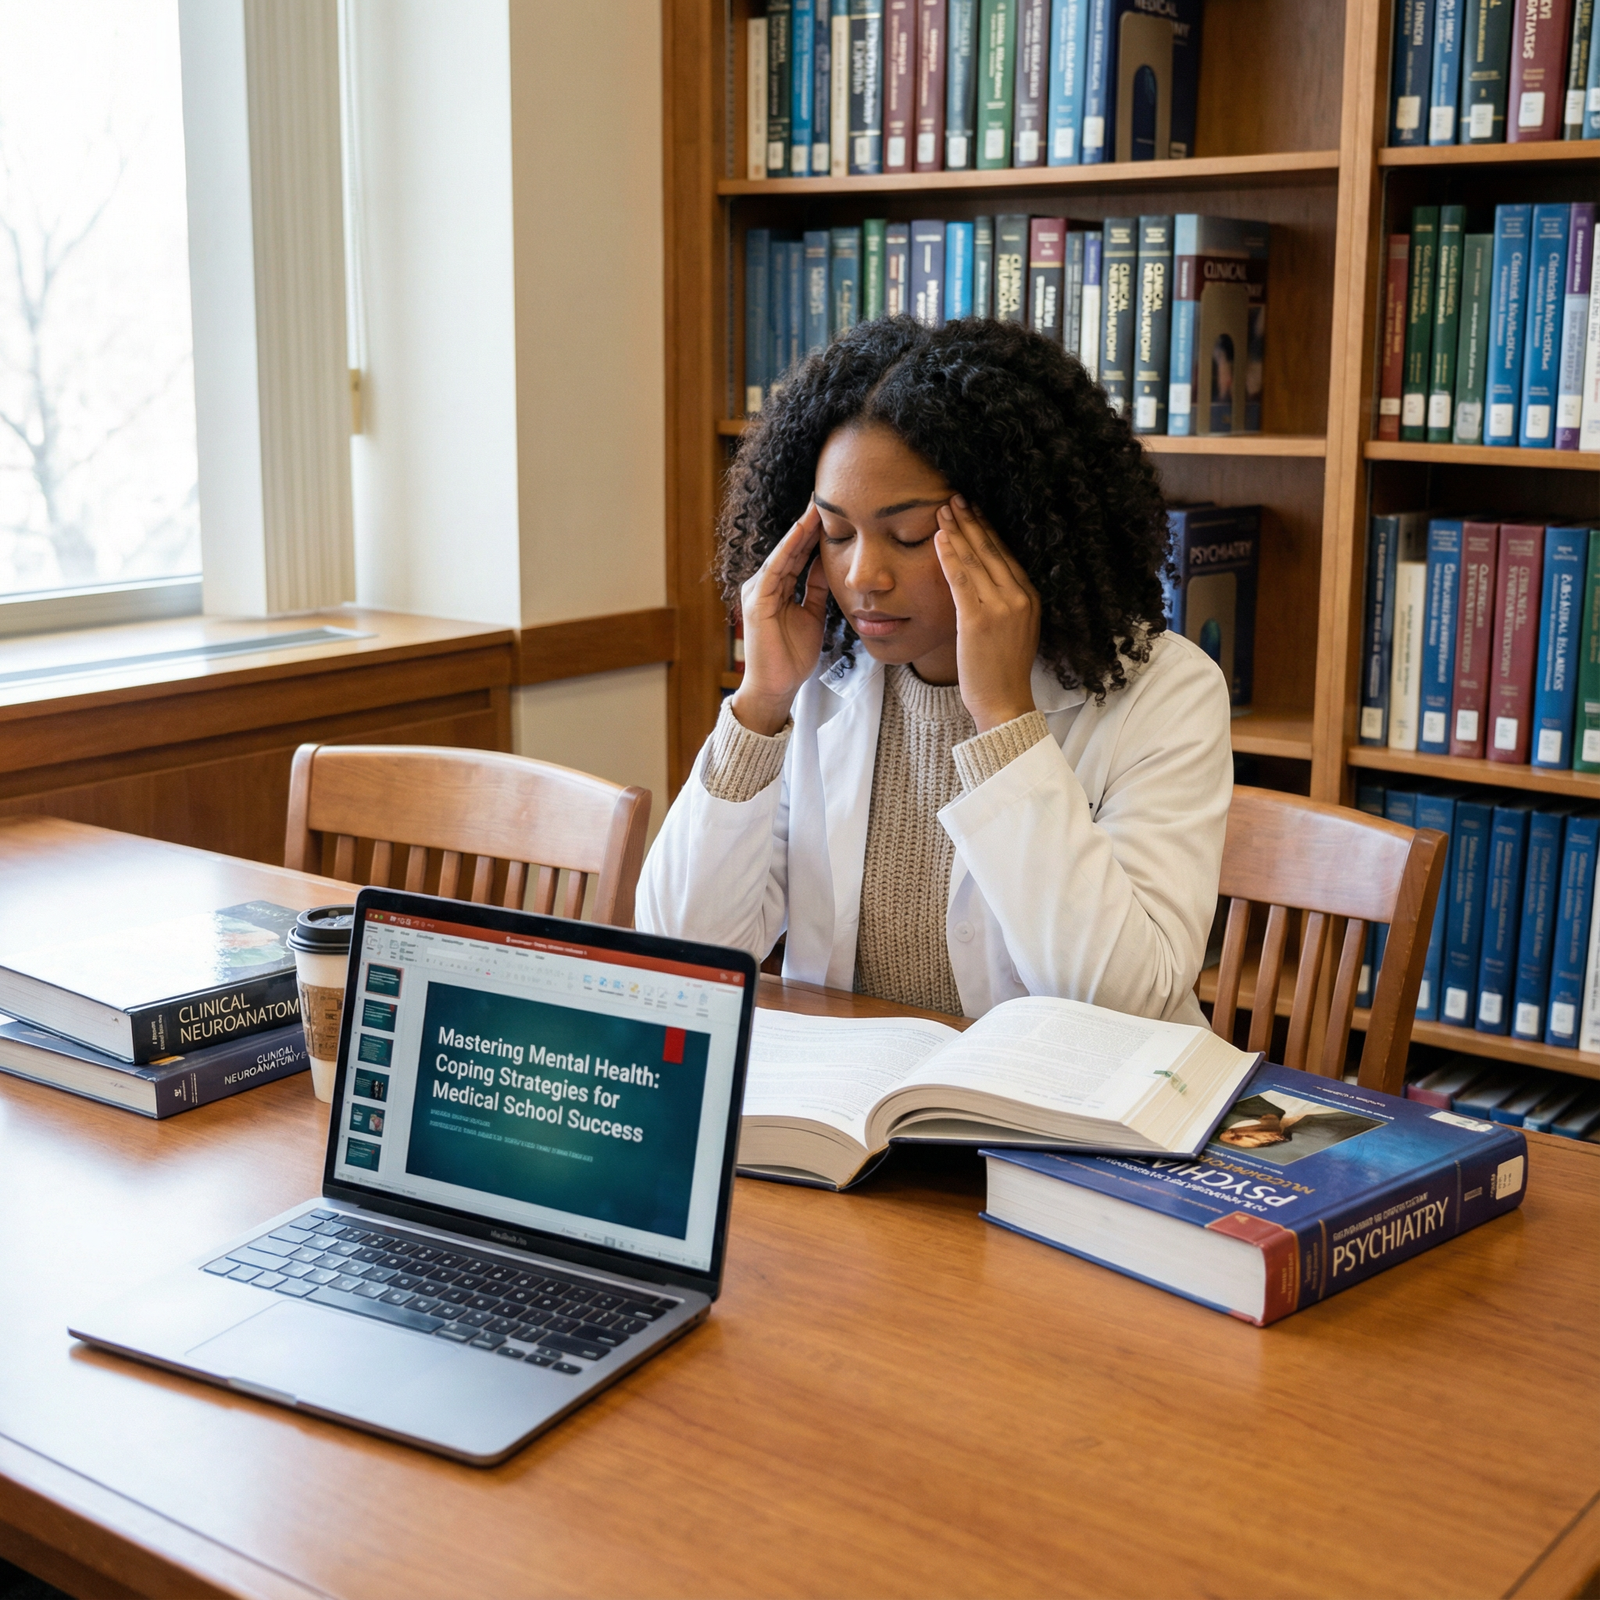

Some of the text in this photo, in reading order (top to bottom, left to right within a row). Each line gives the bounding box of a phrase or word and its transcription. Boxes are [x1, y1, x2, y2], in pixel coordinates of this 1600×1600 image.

[179, 993, 250, 1023] CLINICAL
[180, 998, 300, 1044] NEUROANATOM
[436, 1054, 620, 1109] Coping Strategies for
[438, 1026, 661, 1089] Mastering Mental Health:
[432, 1080, 500, 1111] Medical
[503, 1096, 563, 1125] School
[567, 1110, 643, 1142] Success
[1332, 1197, 1449, 1278] PSYCHIATRY
